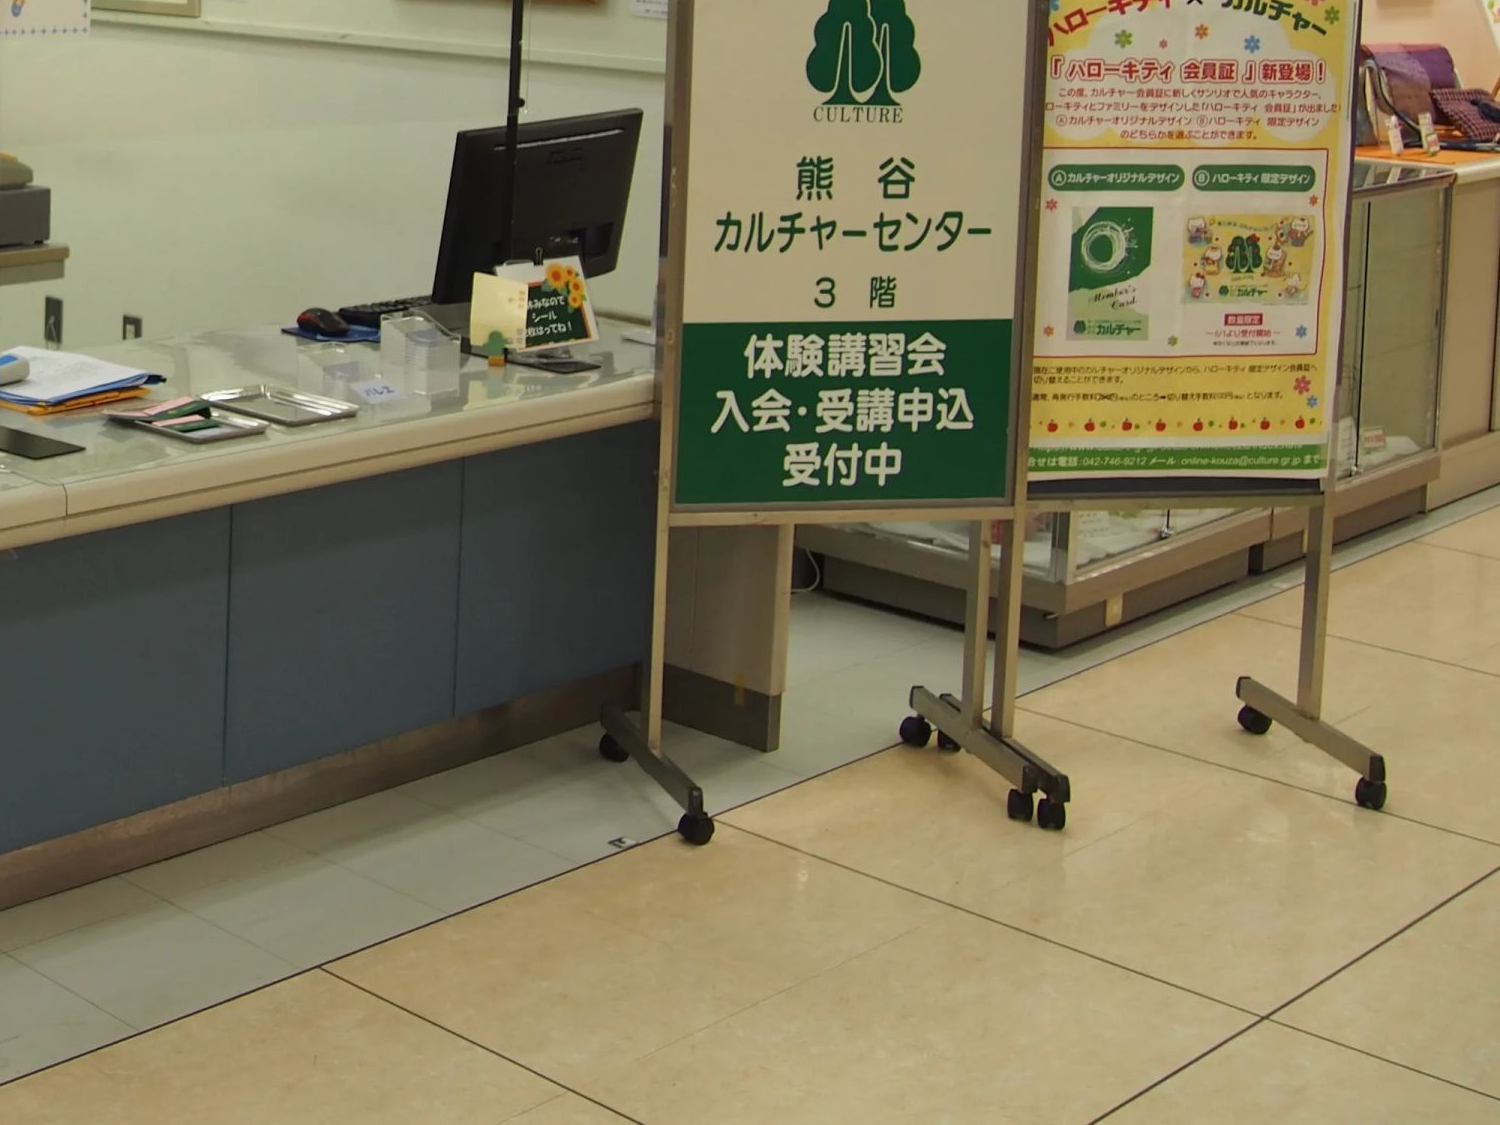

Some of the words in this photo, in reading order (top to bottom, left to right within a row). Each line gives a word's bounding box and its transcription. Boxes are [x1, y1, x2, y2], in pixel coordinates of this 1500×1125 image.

[813, 105, 904, 124] CULTURE
[713, 211, 992, 254] カルチャーセンター
[743, 333, 946, 379] 体験講習会
[710, 387, 975, 434] 入会・受講申込
[782, 441, 902, 487] 受付中
